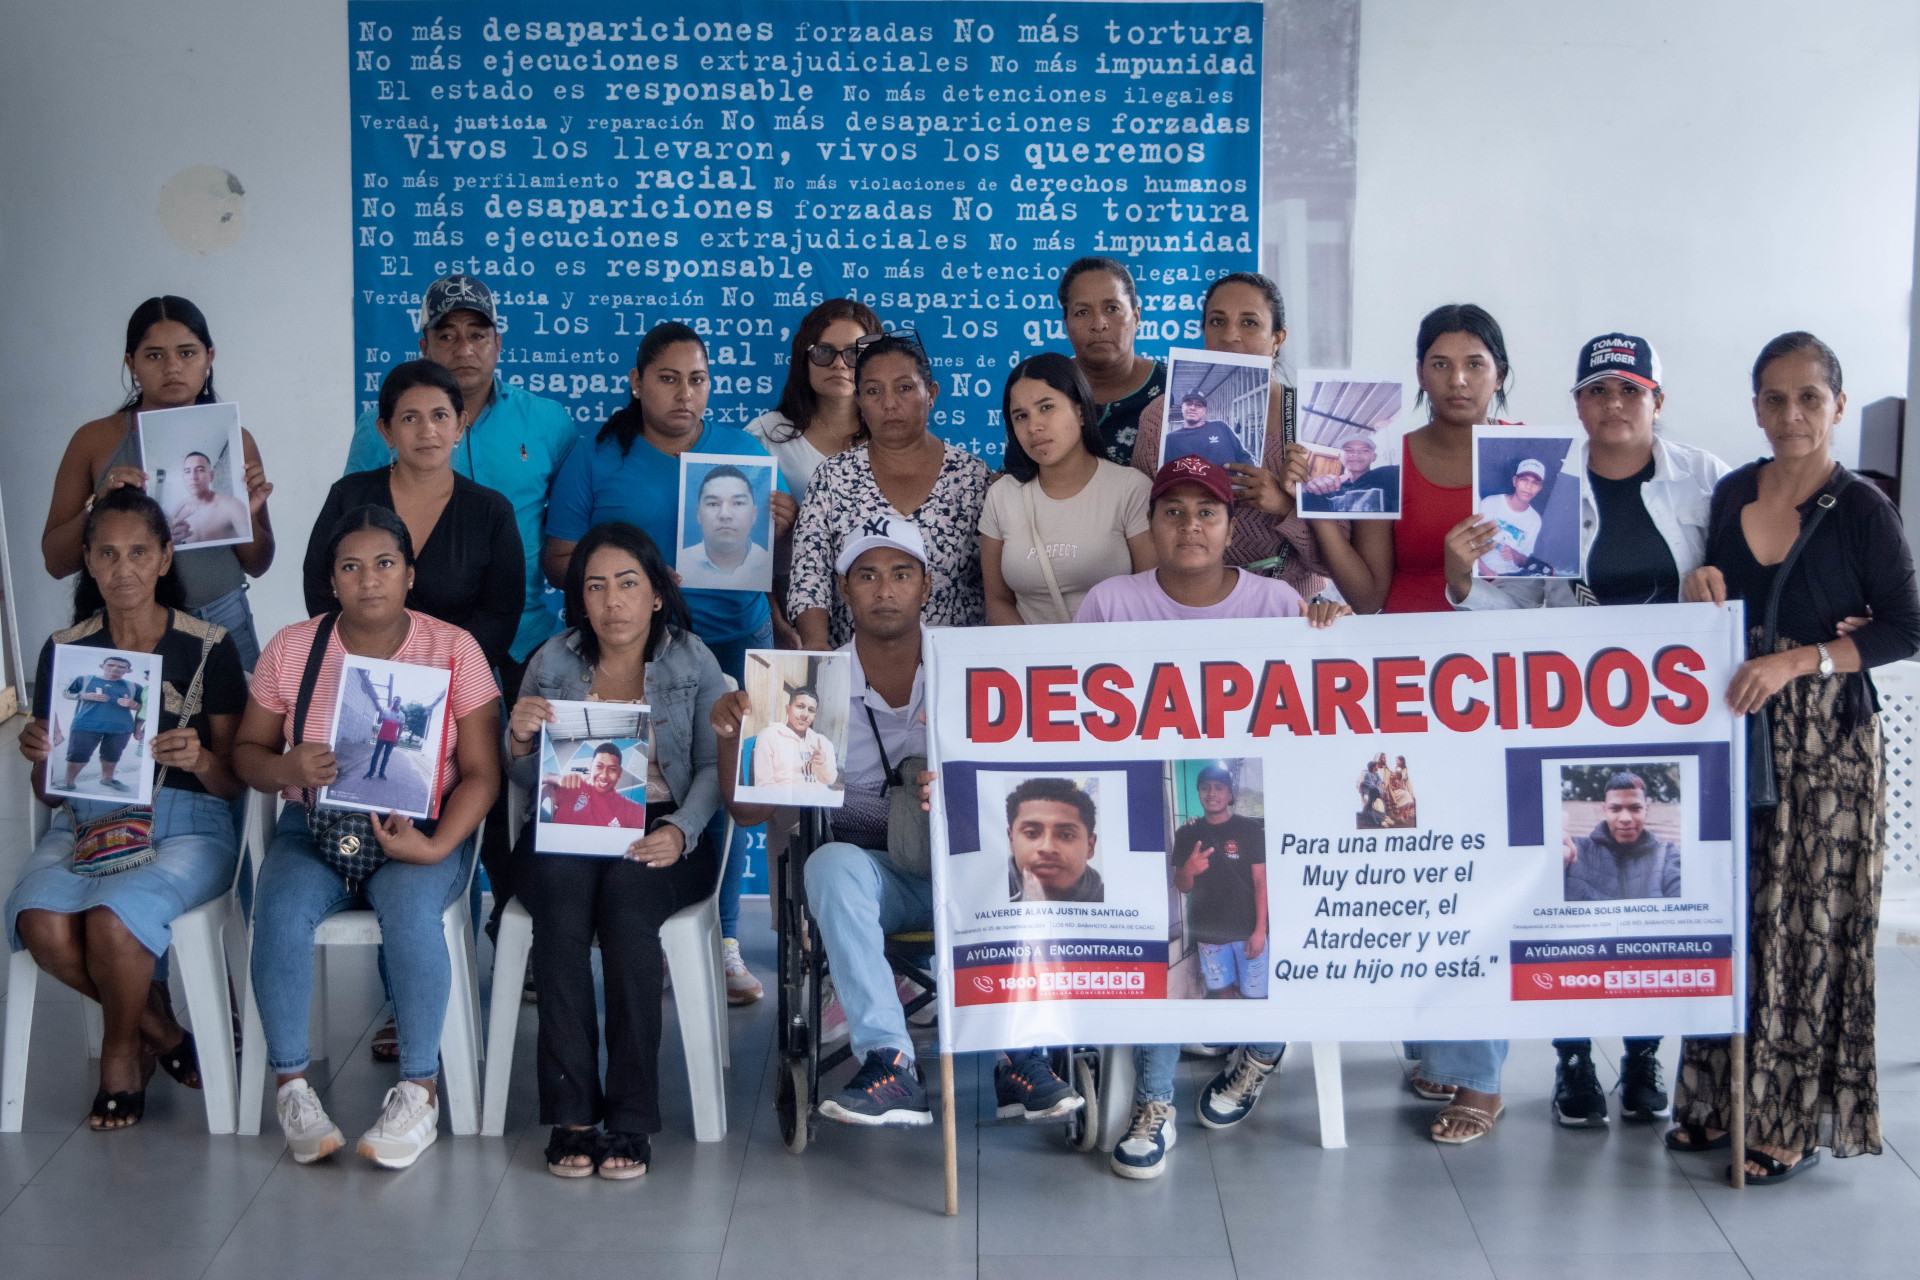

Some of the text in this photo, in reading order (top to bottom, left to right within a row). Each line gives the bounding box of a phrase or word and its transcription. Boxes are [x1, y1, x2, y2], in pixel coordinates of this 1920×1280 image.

[359, 13, 1252, 47] No más desapariciones forzadas No más tortura
[356, 45, 1255, 79] No más ejecuciones extrajudiciales No más impunidad
[378, 78, 1232, 107] El estado es responsable No más detenciones ilegales
[360, 106, 1249, 136] Verdad, justicia y reparación No más desapariciones forzadas
[404, 134, 1205, 169] Vivos los llevaron, vivos los queremos
[364, 165, 1246, 195] No más perfilamiento racial No más violaciones de derechos humanos
[362, 191, 1249, 224] No más desapariciones forzadas No más tortura
[359, 221, 1252, 256] No más ejecuciones extrajudiciales No más impunidad
[381, 256, 413, 275] El
[435, 256, 534, 276] estado
[556, 261, 585, 275] es
[607, 256, 812, 282] responsable
[843, 263, 869, 278] No
[885, 259, 924, 278] más
[941, 261, 1067, 281] detencio
[363, 281, 1064, 313] Verda ticia y reparación No más desaparicion
[534, 312, 589, 335] los
[942, 315, 998, 339] los
[1023, 318, 1202, 346] qumos
[366, 348, 390, 363] No
[497, 346, 619, 364] filamiento
[976, 354, 996, 368] de
[1592, 338, 1636, 351] TOMMY
[1590, 352, 1635, 367] HILFIGER
[364, 372, 381, 392] N
[951, 373, 992, 398] No
[1026, 543, 1078, 559] PRFECT
[966, 644, 1710, 744] DESAPARECIDOS
[1281, 829, 1486, 854] Para una madre es
[1303, 861, 1474, 891] Muy duro ver el
[975, 908, 1022, 920] VALVERDE
[1055, 907, 1088, 916] JUSTIN
[1090, 908, 1140, 917] SANTIAGO
[1314, 893, 1458, 919] Amanecer, el
[1533, 903, 1710, 916] CASTAÑEDA SOLIS MAICOL JEAMPIER
[1303, 927, 1471, 952] Atardecer y ver
[1525, 941, 1712, 957] AYÚDANOS A ENCONTRARLO
[966, 944, 1143, 962] AYÚDANOS A ENCONTRARLO
[999, 977, 1037, 990] 1800
[1275, 959, 1319, 982] Que
[1326, 961, 1346, 979] tu
[1353, 959, 1394, 984] hijo
[1400, 963, 1428, 978] no
[1559, 973, 1602, 988] 1800
